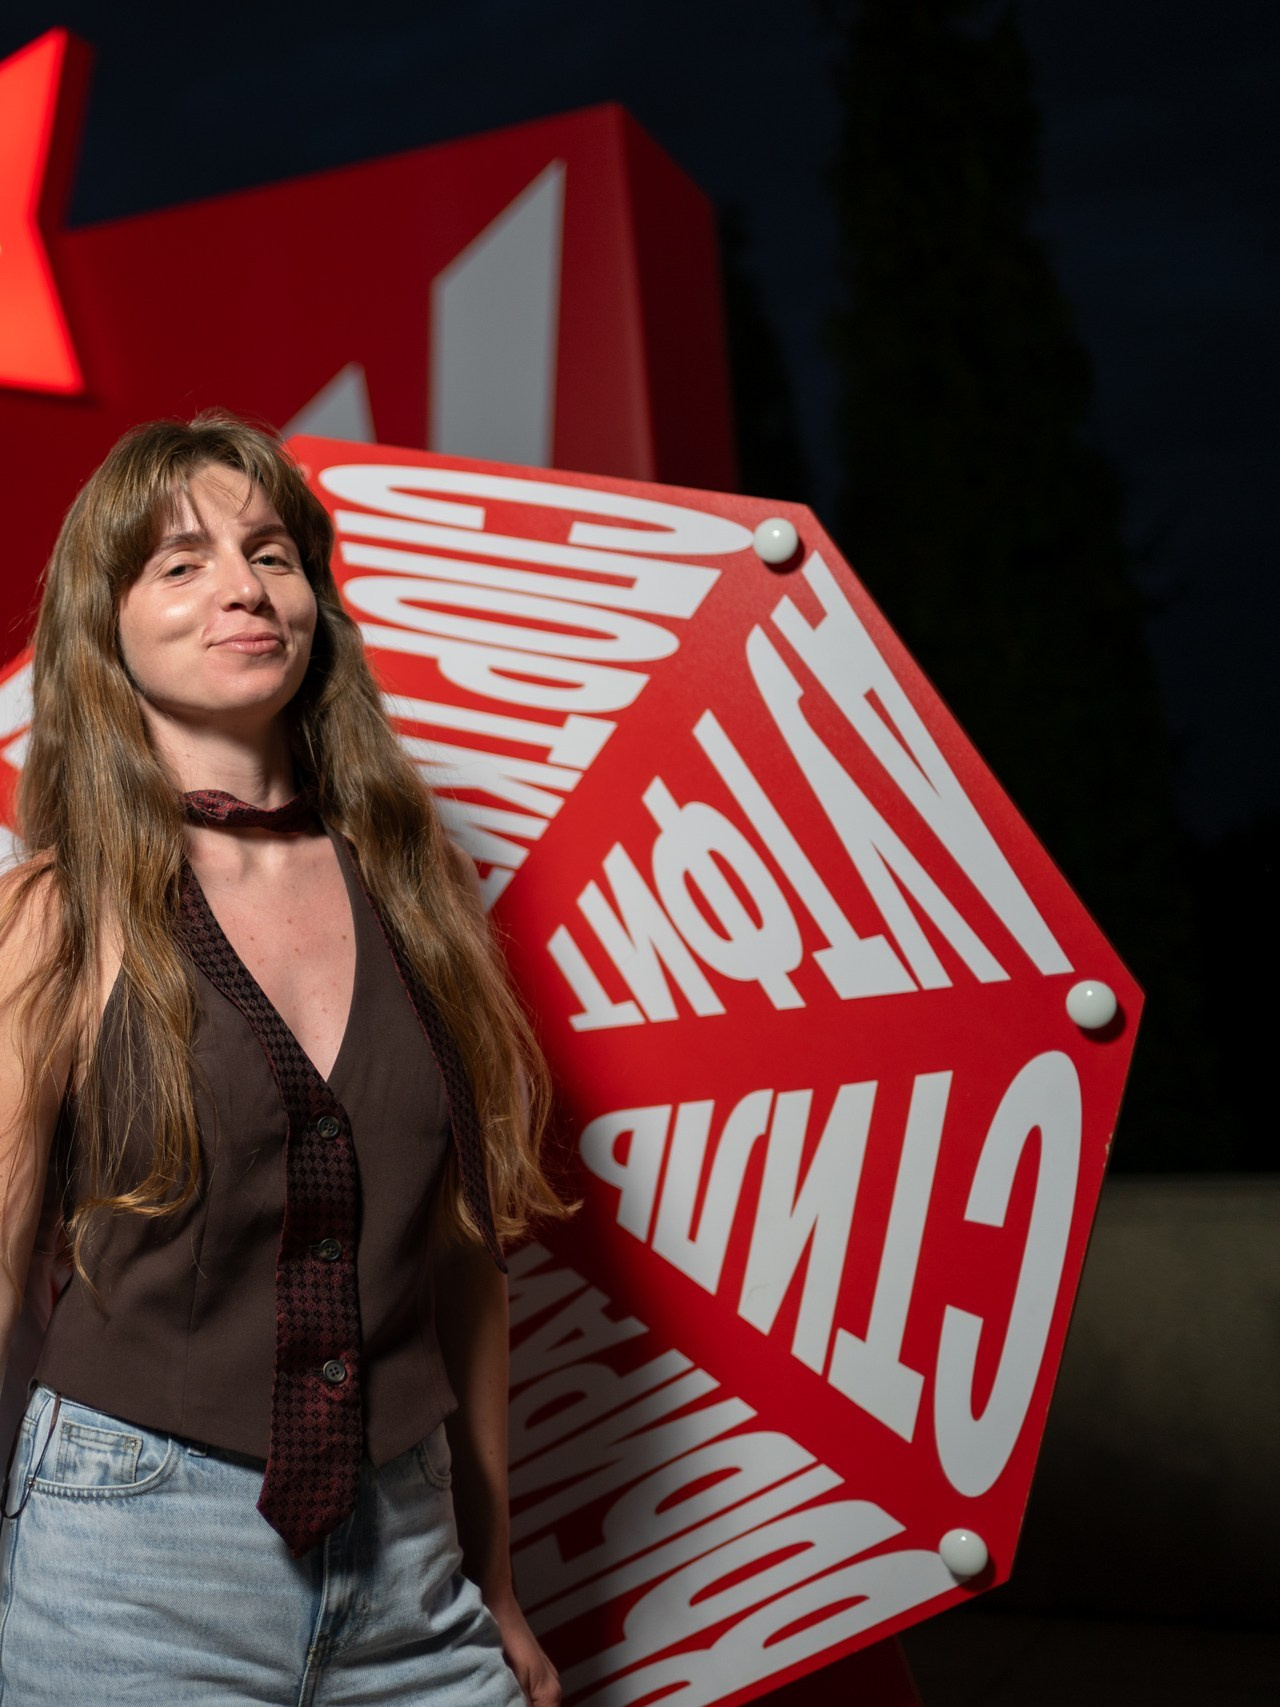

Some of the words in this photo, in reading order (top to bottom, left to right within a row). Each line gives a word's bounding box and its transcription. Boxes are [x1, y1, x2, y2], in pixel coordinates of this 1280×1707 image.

[320, 464, 756, 914] СПОРТКИ
[547, 551, 1075, 1032] АУТФИТ
[579, 1050, 1083, 1498] СТИЛЬ
